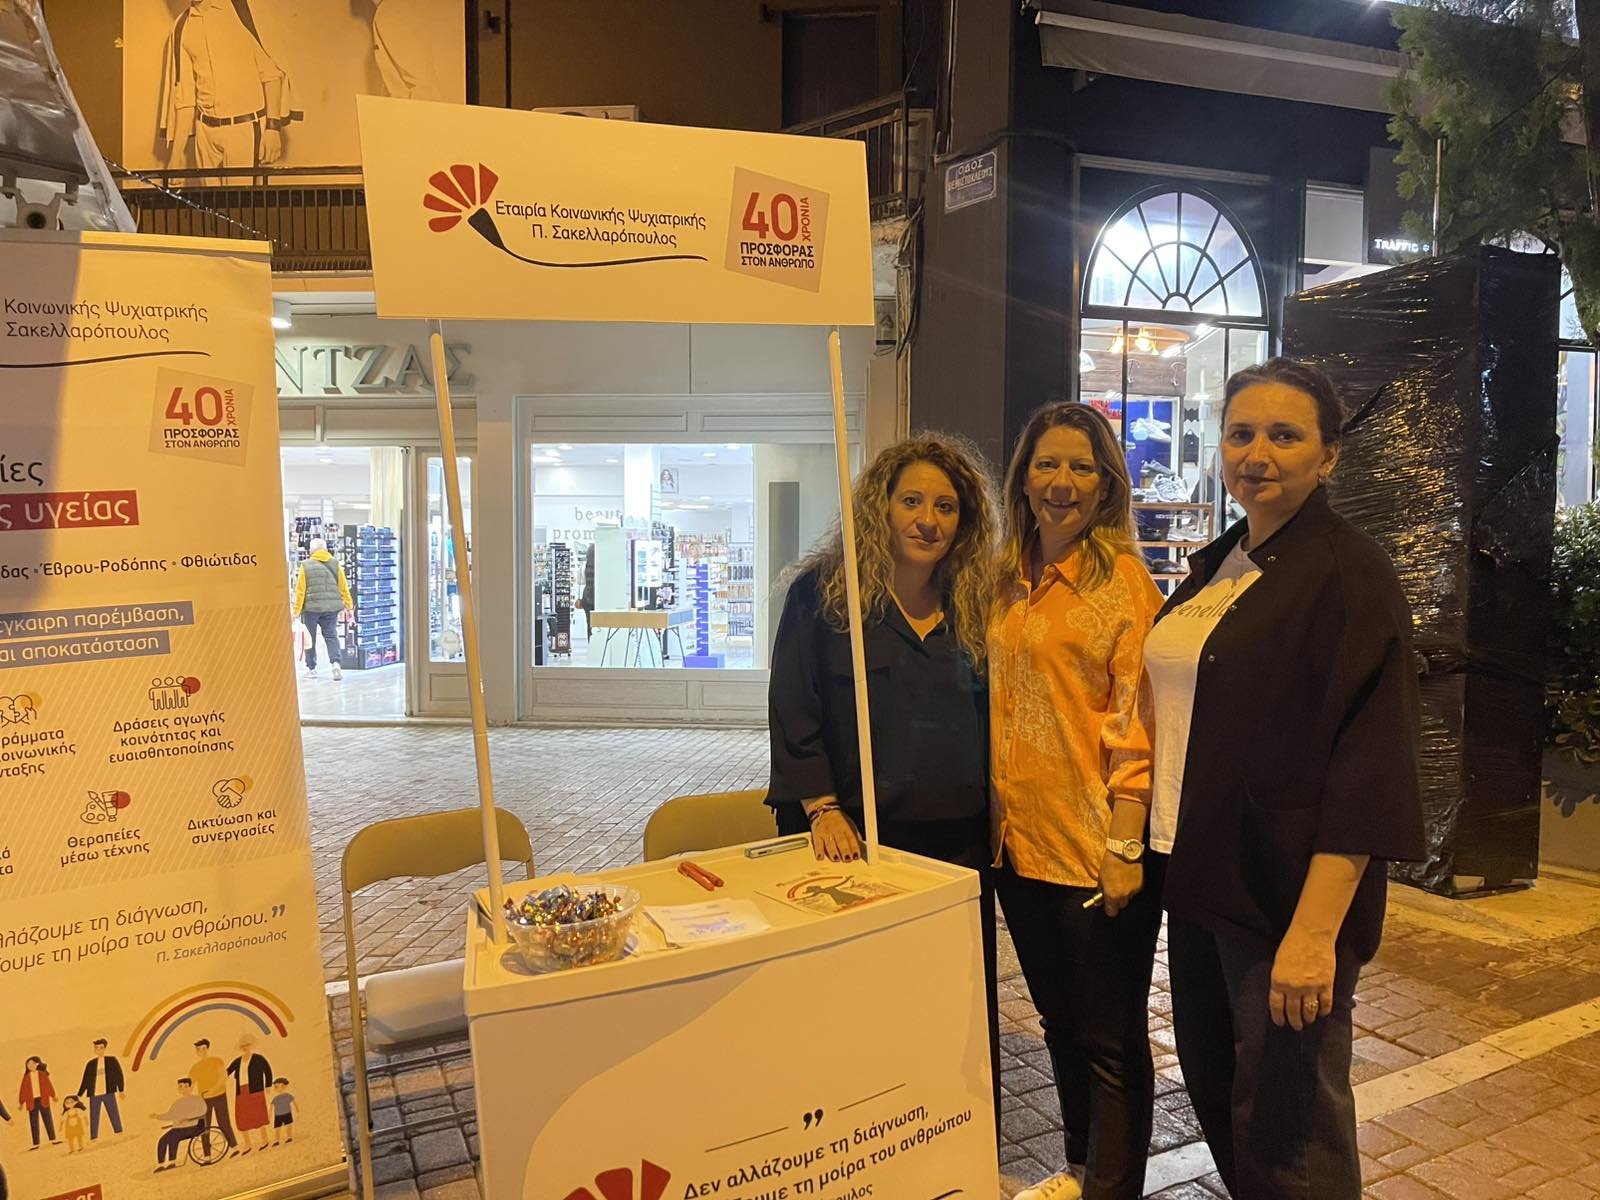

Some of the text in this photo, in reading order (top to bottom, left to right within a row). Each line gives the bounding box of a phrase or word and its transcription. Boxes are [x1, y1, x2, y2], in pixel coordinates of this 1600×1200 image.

[495, 200, 706, 230] Εταιρία Κοινωνικής Ψυχιατρικής
[742, 192, 798, 241] 40
[800, 197, 811, 242] ΧΡΟΝΙΑ
[532, 223, 677, 248] Π. Σακελλαρόπουλος
[740, 242, 814, 257] ΠΡΟΣΦΟΡΑΣ
[741, 256, 815, 268] ΣΤΟΝ ΑΝΘΡΩΠΟ
[4, 298, 208, 322] Κοινωνικής Ψυχιατρικής
[6, 322, 169, 342] Σακελλαρόπουλος
[165, 386, 223, 426] 40
[225, 388, 236, 426] ΧΡΟΝΙΑ
[164, 428, 240, 439] ΠΡΟΣΦΟΡΑΣ
[165, 439, 240, 448] ΣΤΟΝ ΑΝΘΡΩΠΟ
[25, 493, 130, 528] υγείας
[1, 553, 257, 579] δας Έβρου-Ροδόπης Φθιώτιδας
[74, 607, 184, 628] παρέμβαση,
[22, 637, 159, 660] αποκατάσταση
[113, 710, 225, 733] Δράσεις αγωγής
[1, 730, 64, 748] ράμματα
[120, 728, 221, 746] κοινότητας και
[0, 742, 76, 761] οινωνικής
[109, 740, 234, 763] ευαισθητοποίησης
[188, 809, 277, 830] Δικτύωση και
[67, 828, 140, 848] Θεραπείες
[192, 823, 275, 844] συνεργασίες
[60, 842, 150, 867] μέσω τέχνης
[89, 917, 109, 931] τη
[116, 900, 208, 926] διάγνωση,
[0, 953, 45, 973] ουμε
[51, 948, 71, 963] τη
[78, 936, 129, 961] μοίρα
[136, 930, 166, 945] του
[156, 930, 287, 963] Π. Σακελλαρόπουλος
[684, 1179, 721, 1200] Δεν
[727, 1146, 825, 1188] αλλάζουμε
[830, 1138, 849, 1153] τη
[853, 1106, 928, 1145] διάγνωση,
[793, 1178, 814, 1194] τη
[819, 1158, 866, 1190] μοίρα
[869, 1145, 896, 1165] του
[900, 1110, 972, 1152] ανθρώπου
